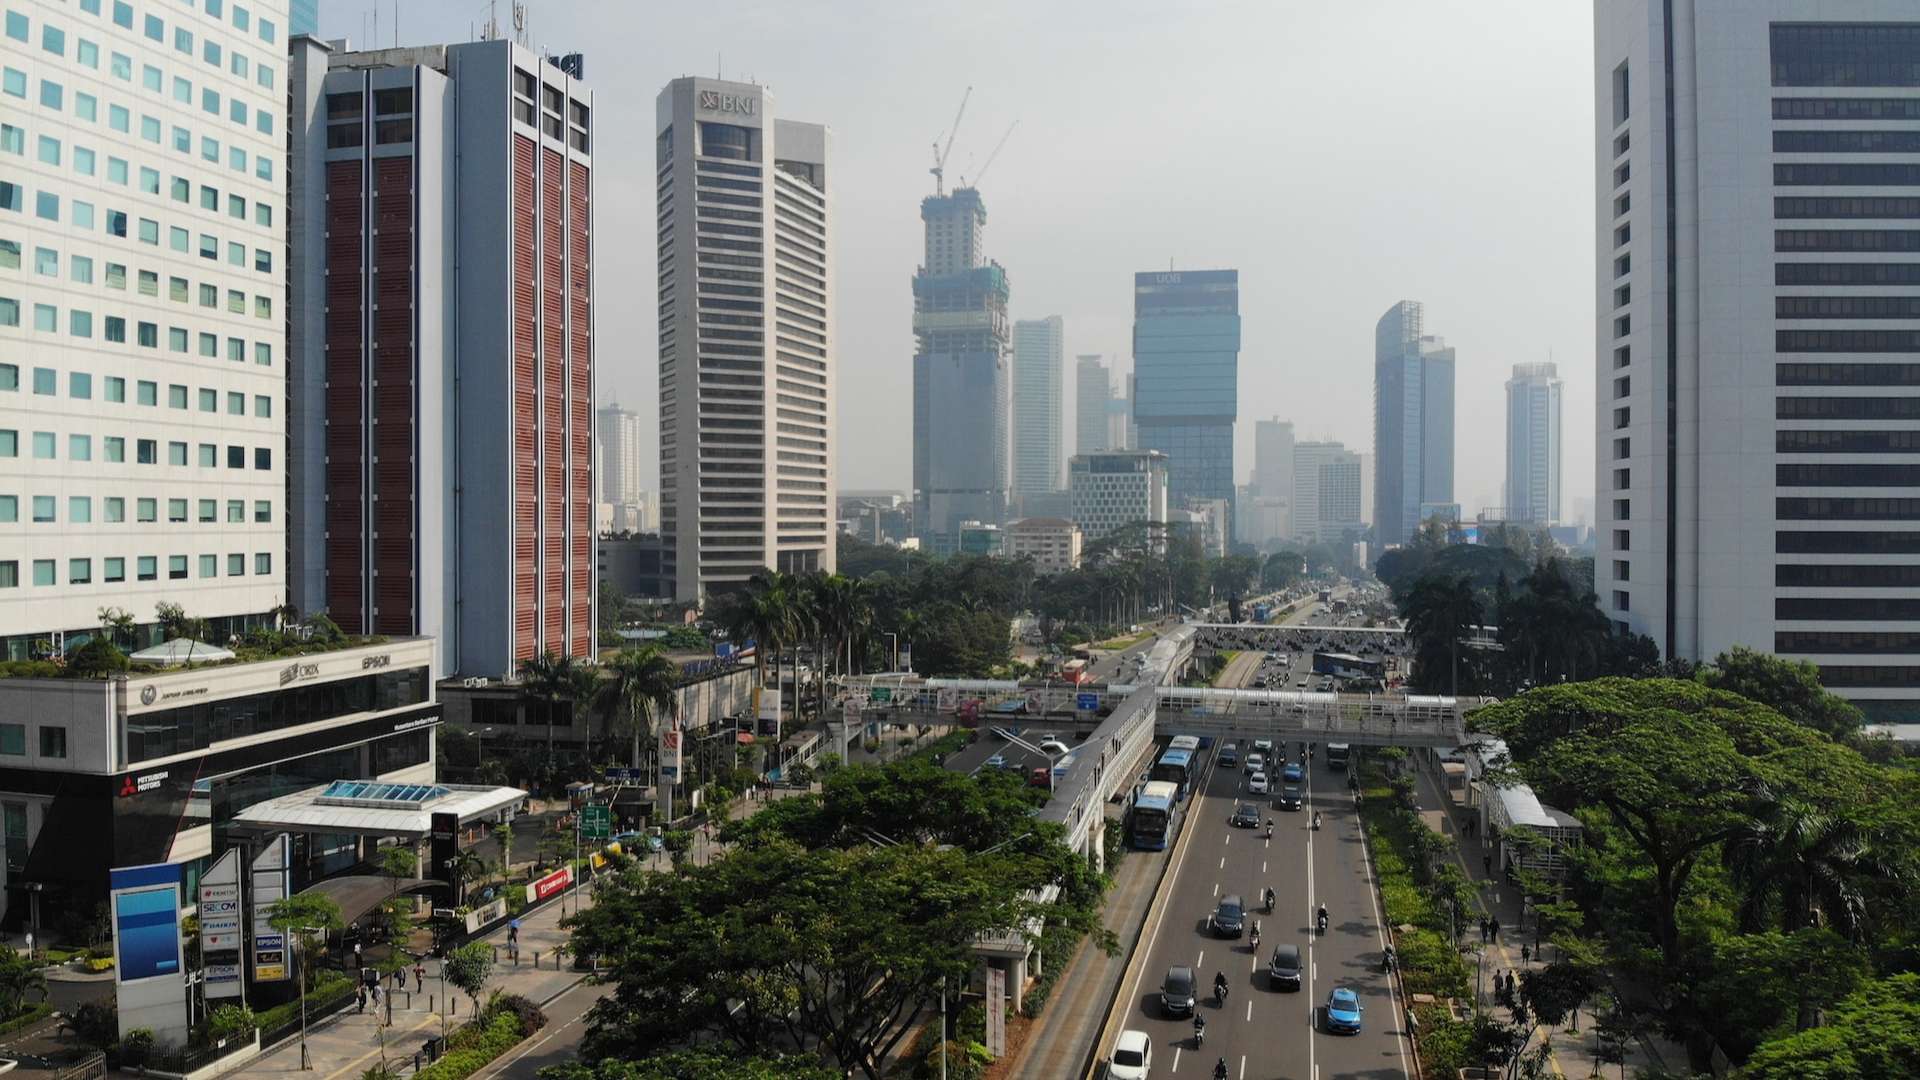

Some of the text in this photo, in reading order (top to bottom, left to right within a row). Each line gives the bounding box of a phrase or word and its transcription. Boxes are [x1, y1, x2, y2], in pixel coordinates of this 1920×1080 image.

[721, 94, 756, 115] BNI
[362, 654, 391, 670] EPSON
[137, 771, 169, 784] MITSUBISHI
[138, 780, 161, 792] MOTORS
[203, 902, 236, 913] SECOM
[257, 937, 280, 946] EPSON
[209, 966, 235, 974] EPSON
